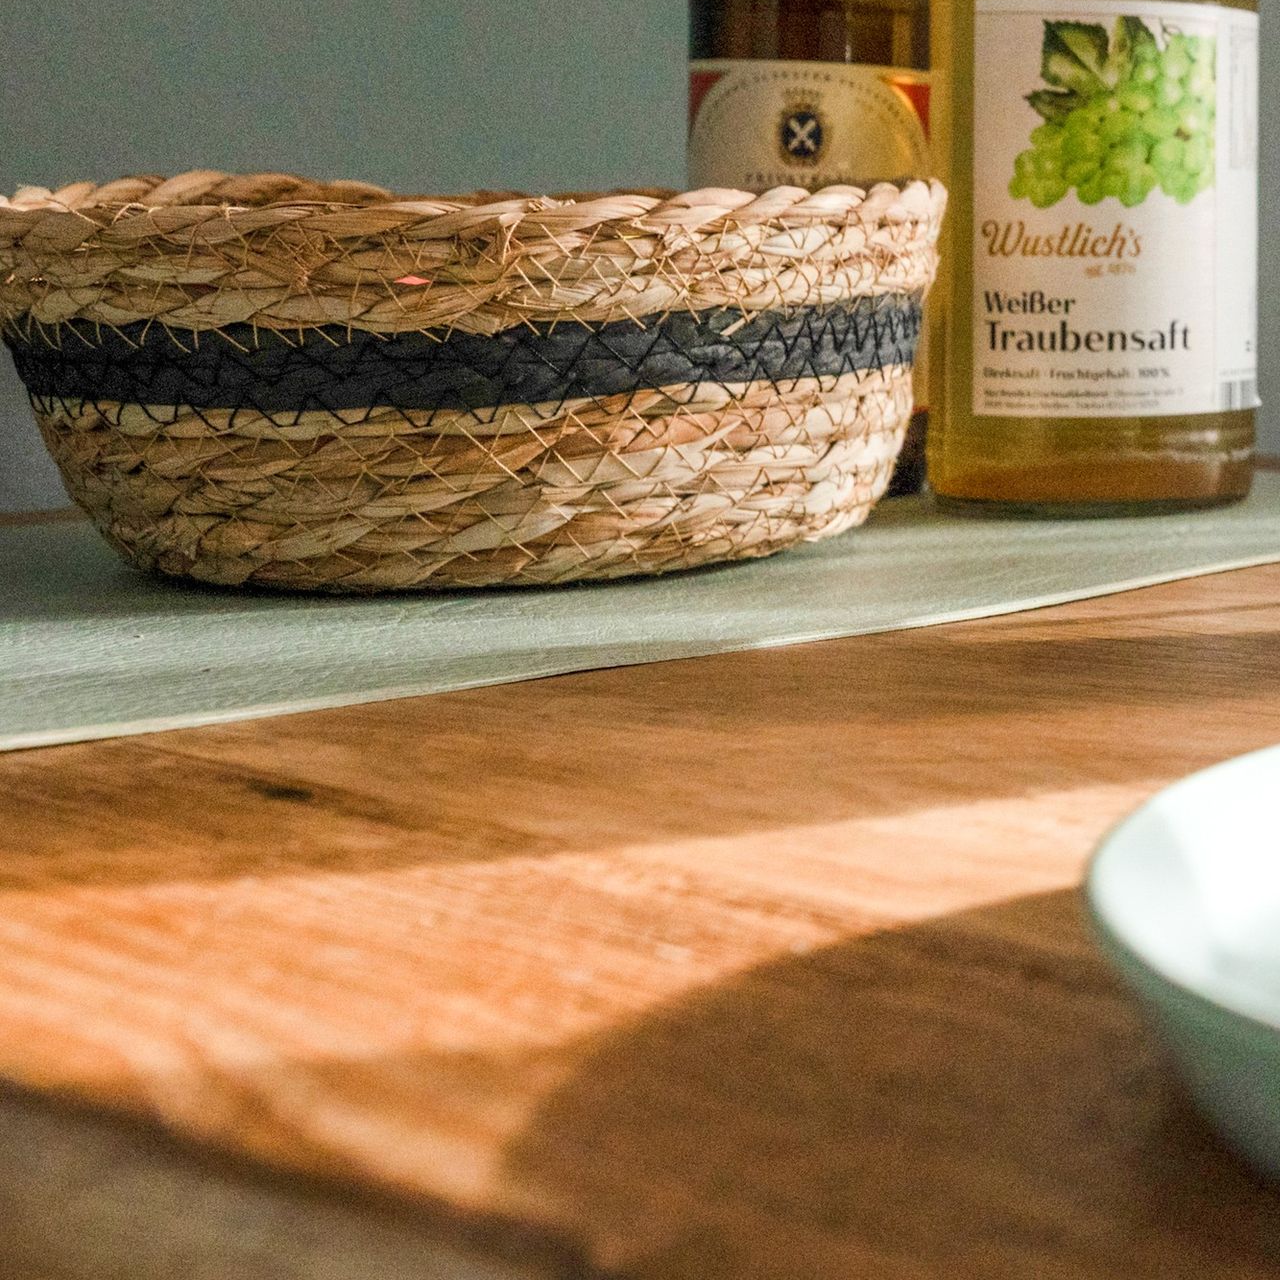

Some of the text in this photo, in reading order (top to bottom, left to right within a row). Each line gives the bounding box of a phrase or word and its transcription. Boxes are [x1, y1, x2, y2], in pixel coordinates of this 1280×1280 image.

[981, 219, 1143, 259] Wustlich's
[984, 290, 1077, 315] Weißer
[984, 320, 1190, 353] Traubensaft
